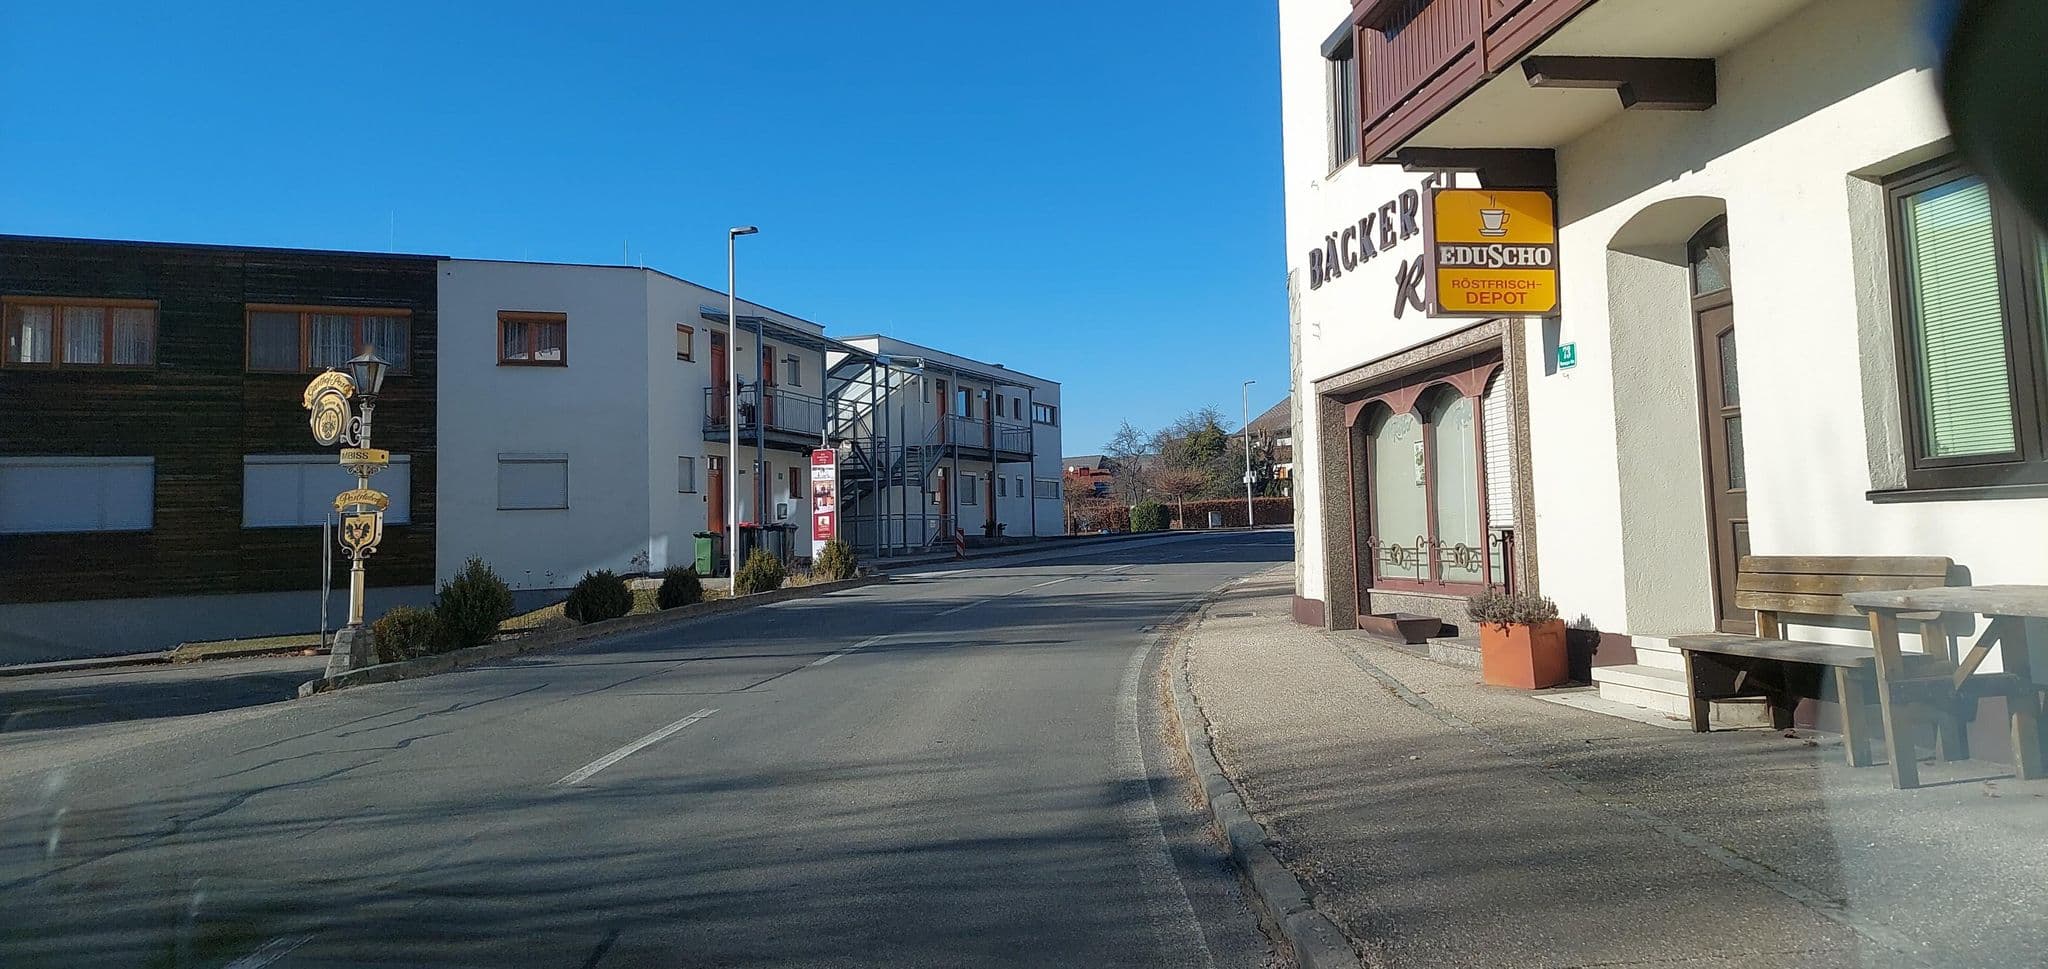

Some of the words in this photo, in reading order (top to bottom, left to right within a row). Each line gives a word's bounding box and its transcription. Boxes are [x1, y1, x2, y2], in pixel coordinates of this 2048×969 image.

[1439, 244, 1552, 269] EDUSCHO
[1451, 277, 1543, 290] RÖSTFRISCH-
[1466, 291, 1528, 305] DEPOT
